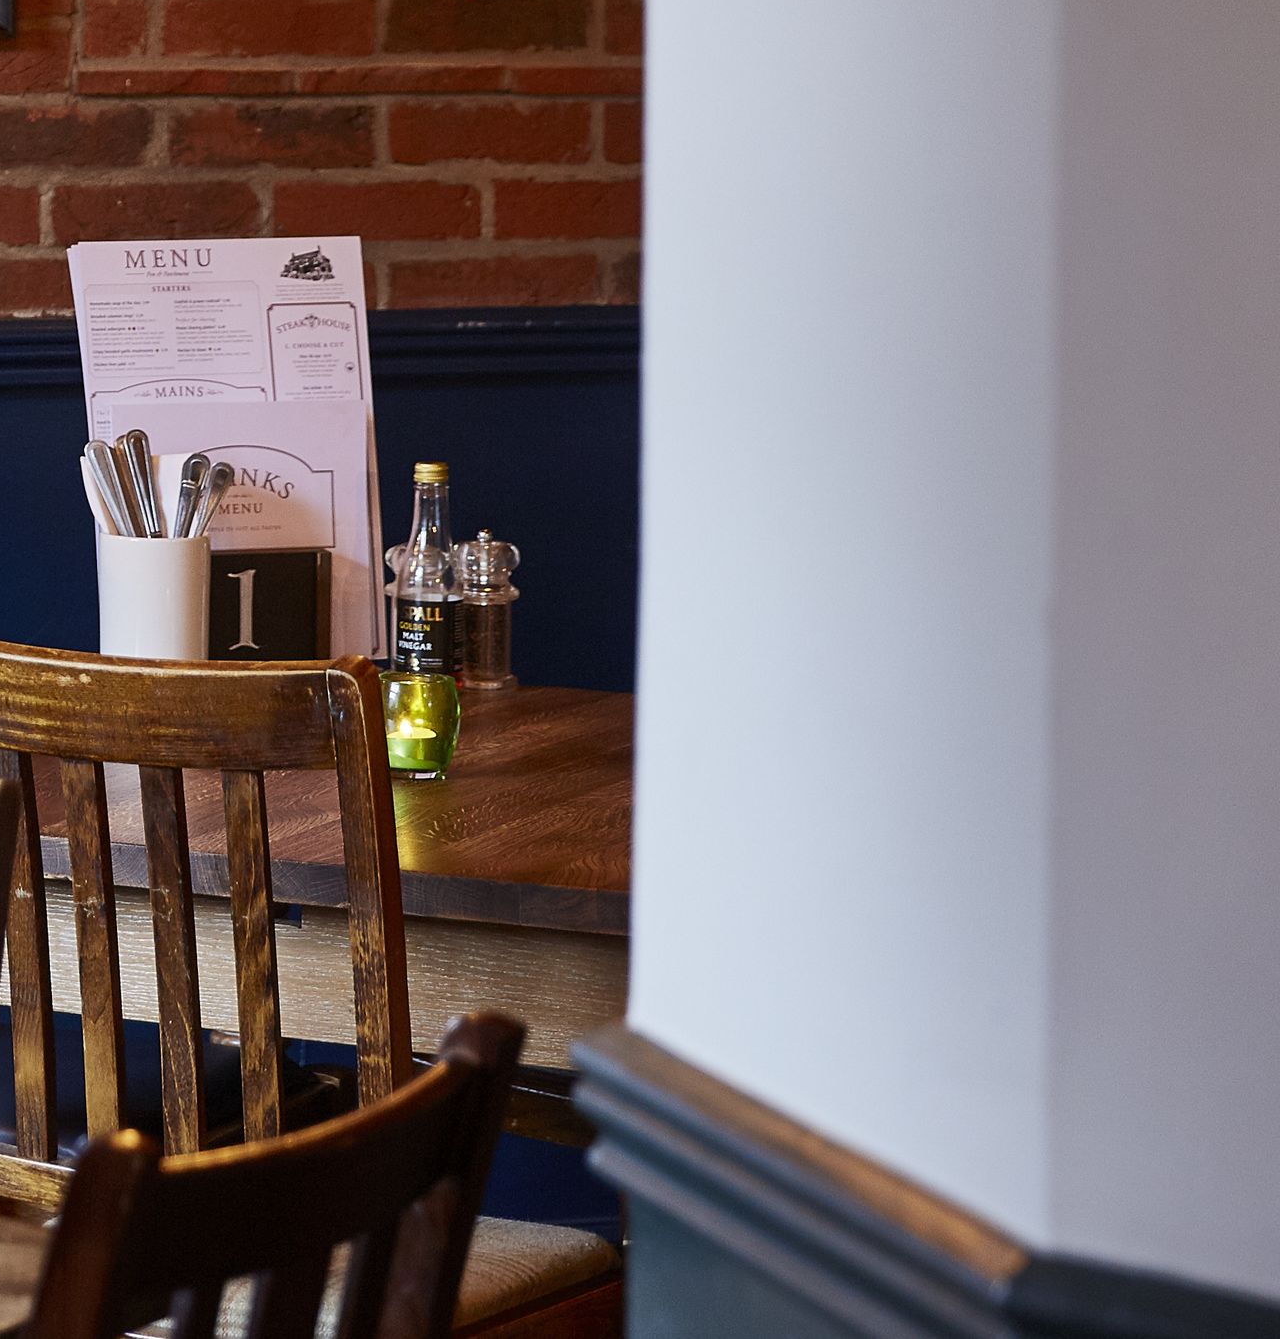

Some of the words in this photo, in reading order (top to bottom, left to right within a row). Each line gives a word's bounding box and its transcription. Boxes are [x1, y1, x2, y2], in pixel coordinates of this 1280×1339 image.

[124, 248, 212, 269] MENU
[155, 386, 204, 398] MAINS
[229, 468, 295, 499] NKS
[218, 503, 263, 515] MENU
[227, 569, 260, 650] 1
[402, 631, 425, 641] MALT
[398, 640, 432, 650] VINEGAR
